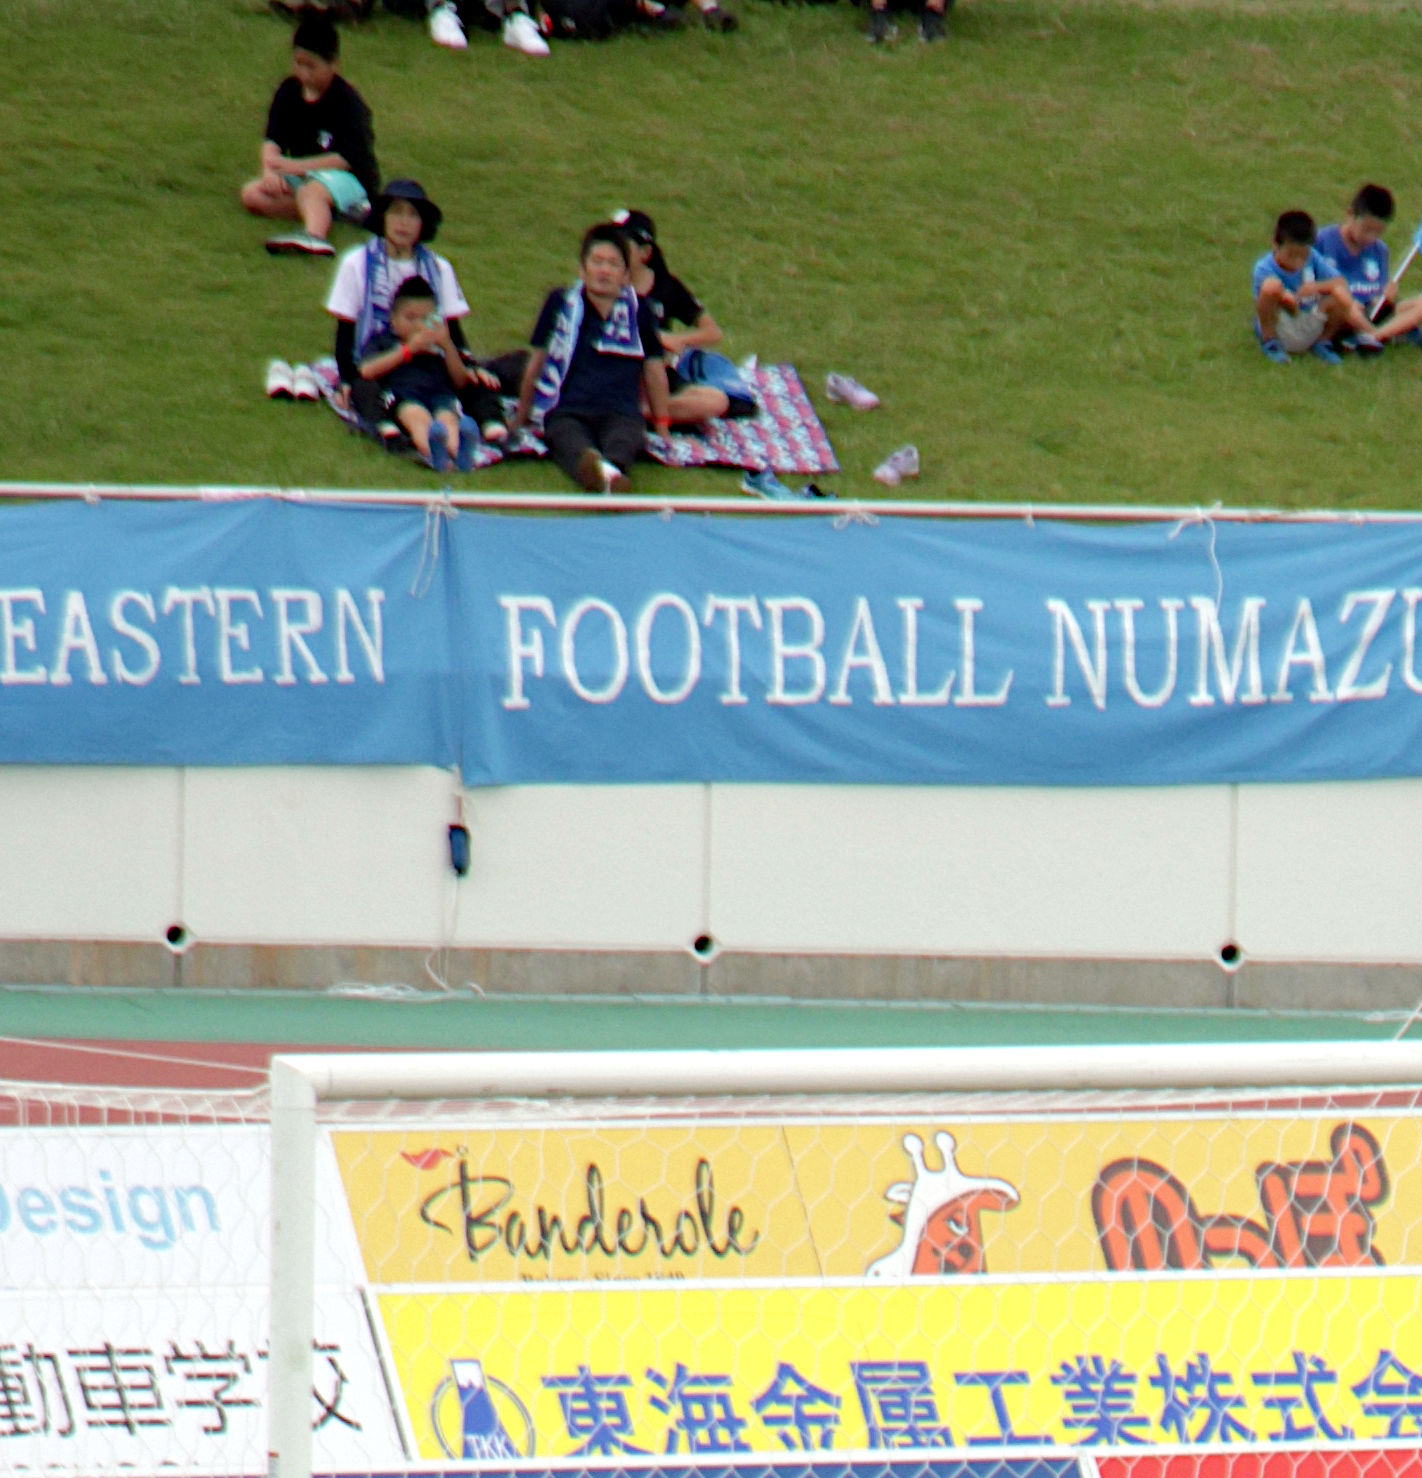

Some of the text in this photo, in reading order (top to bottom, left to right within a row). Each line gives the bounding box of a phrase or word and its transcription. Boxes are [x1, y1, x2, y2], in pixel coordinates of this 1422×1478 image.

[0, 586, 386, 685] EASTERN
[498, 592, 1013, 709] FOOTBALL
[420, 1157, 760, 1262] Banderole
